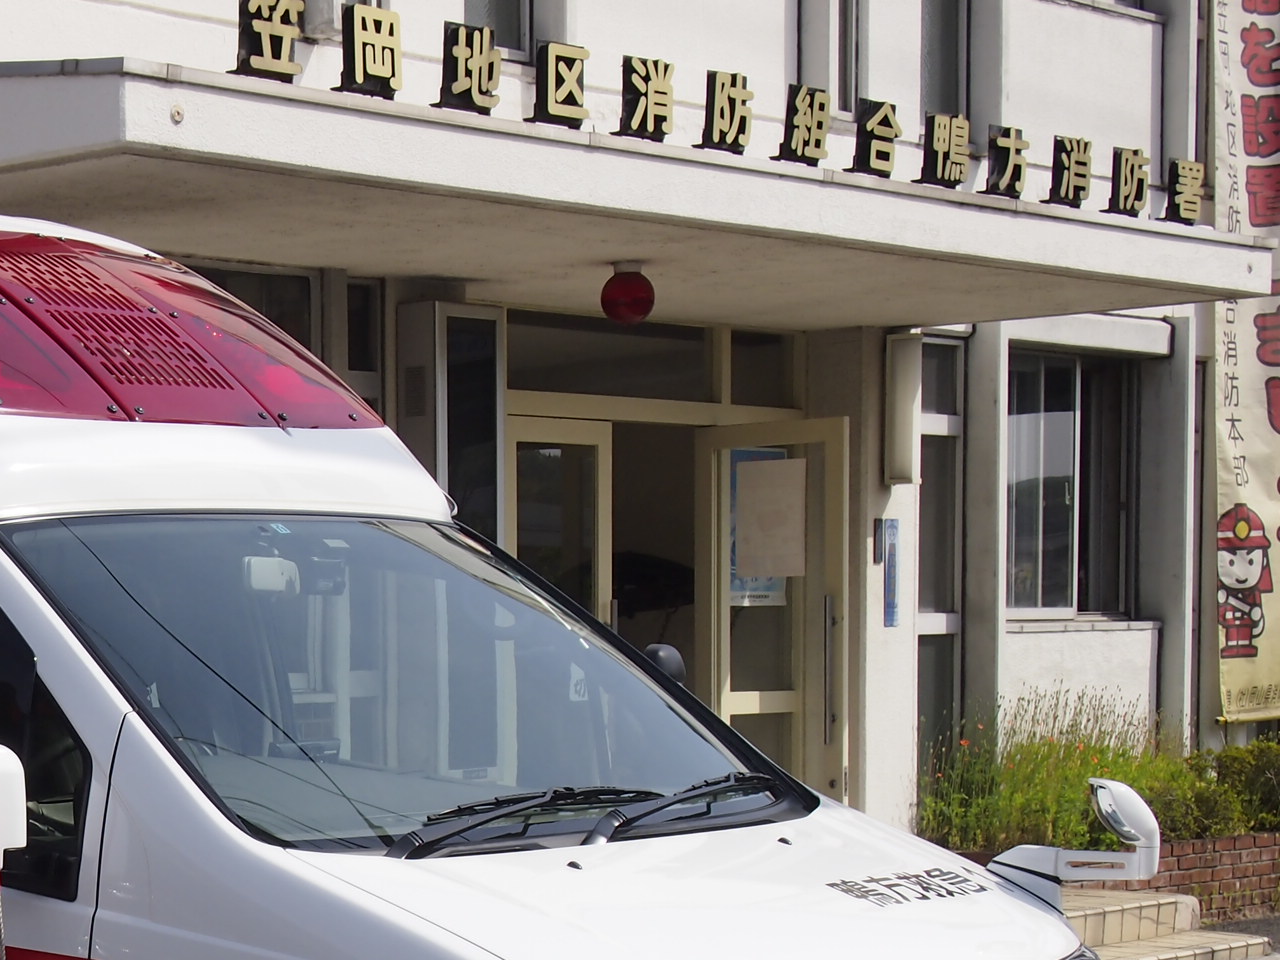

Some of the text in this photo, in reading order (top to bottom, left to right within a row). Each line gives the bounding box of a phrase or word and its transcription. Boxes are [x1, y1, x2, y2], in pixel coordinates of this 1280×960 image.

[247, 0, 1205, 223] 笠岡地区消防組合鴨方消防署
